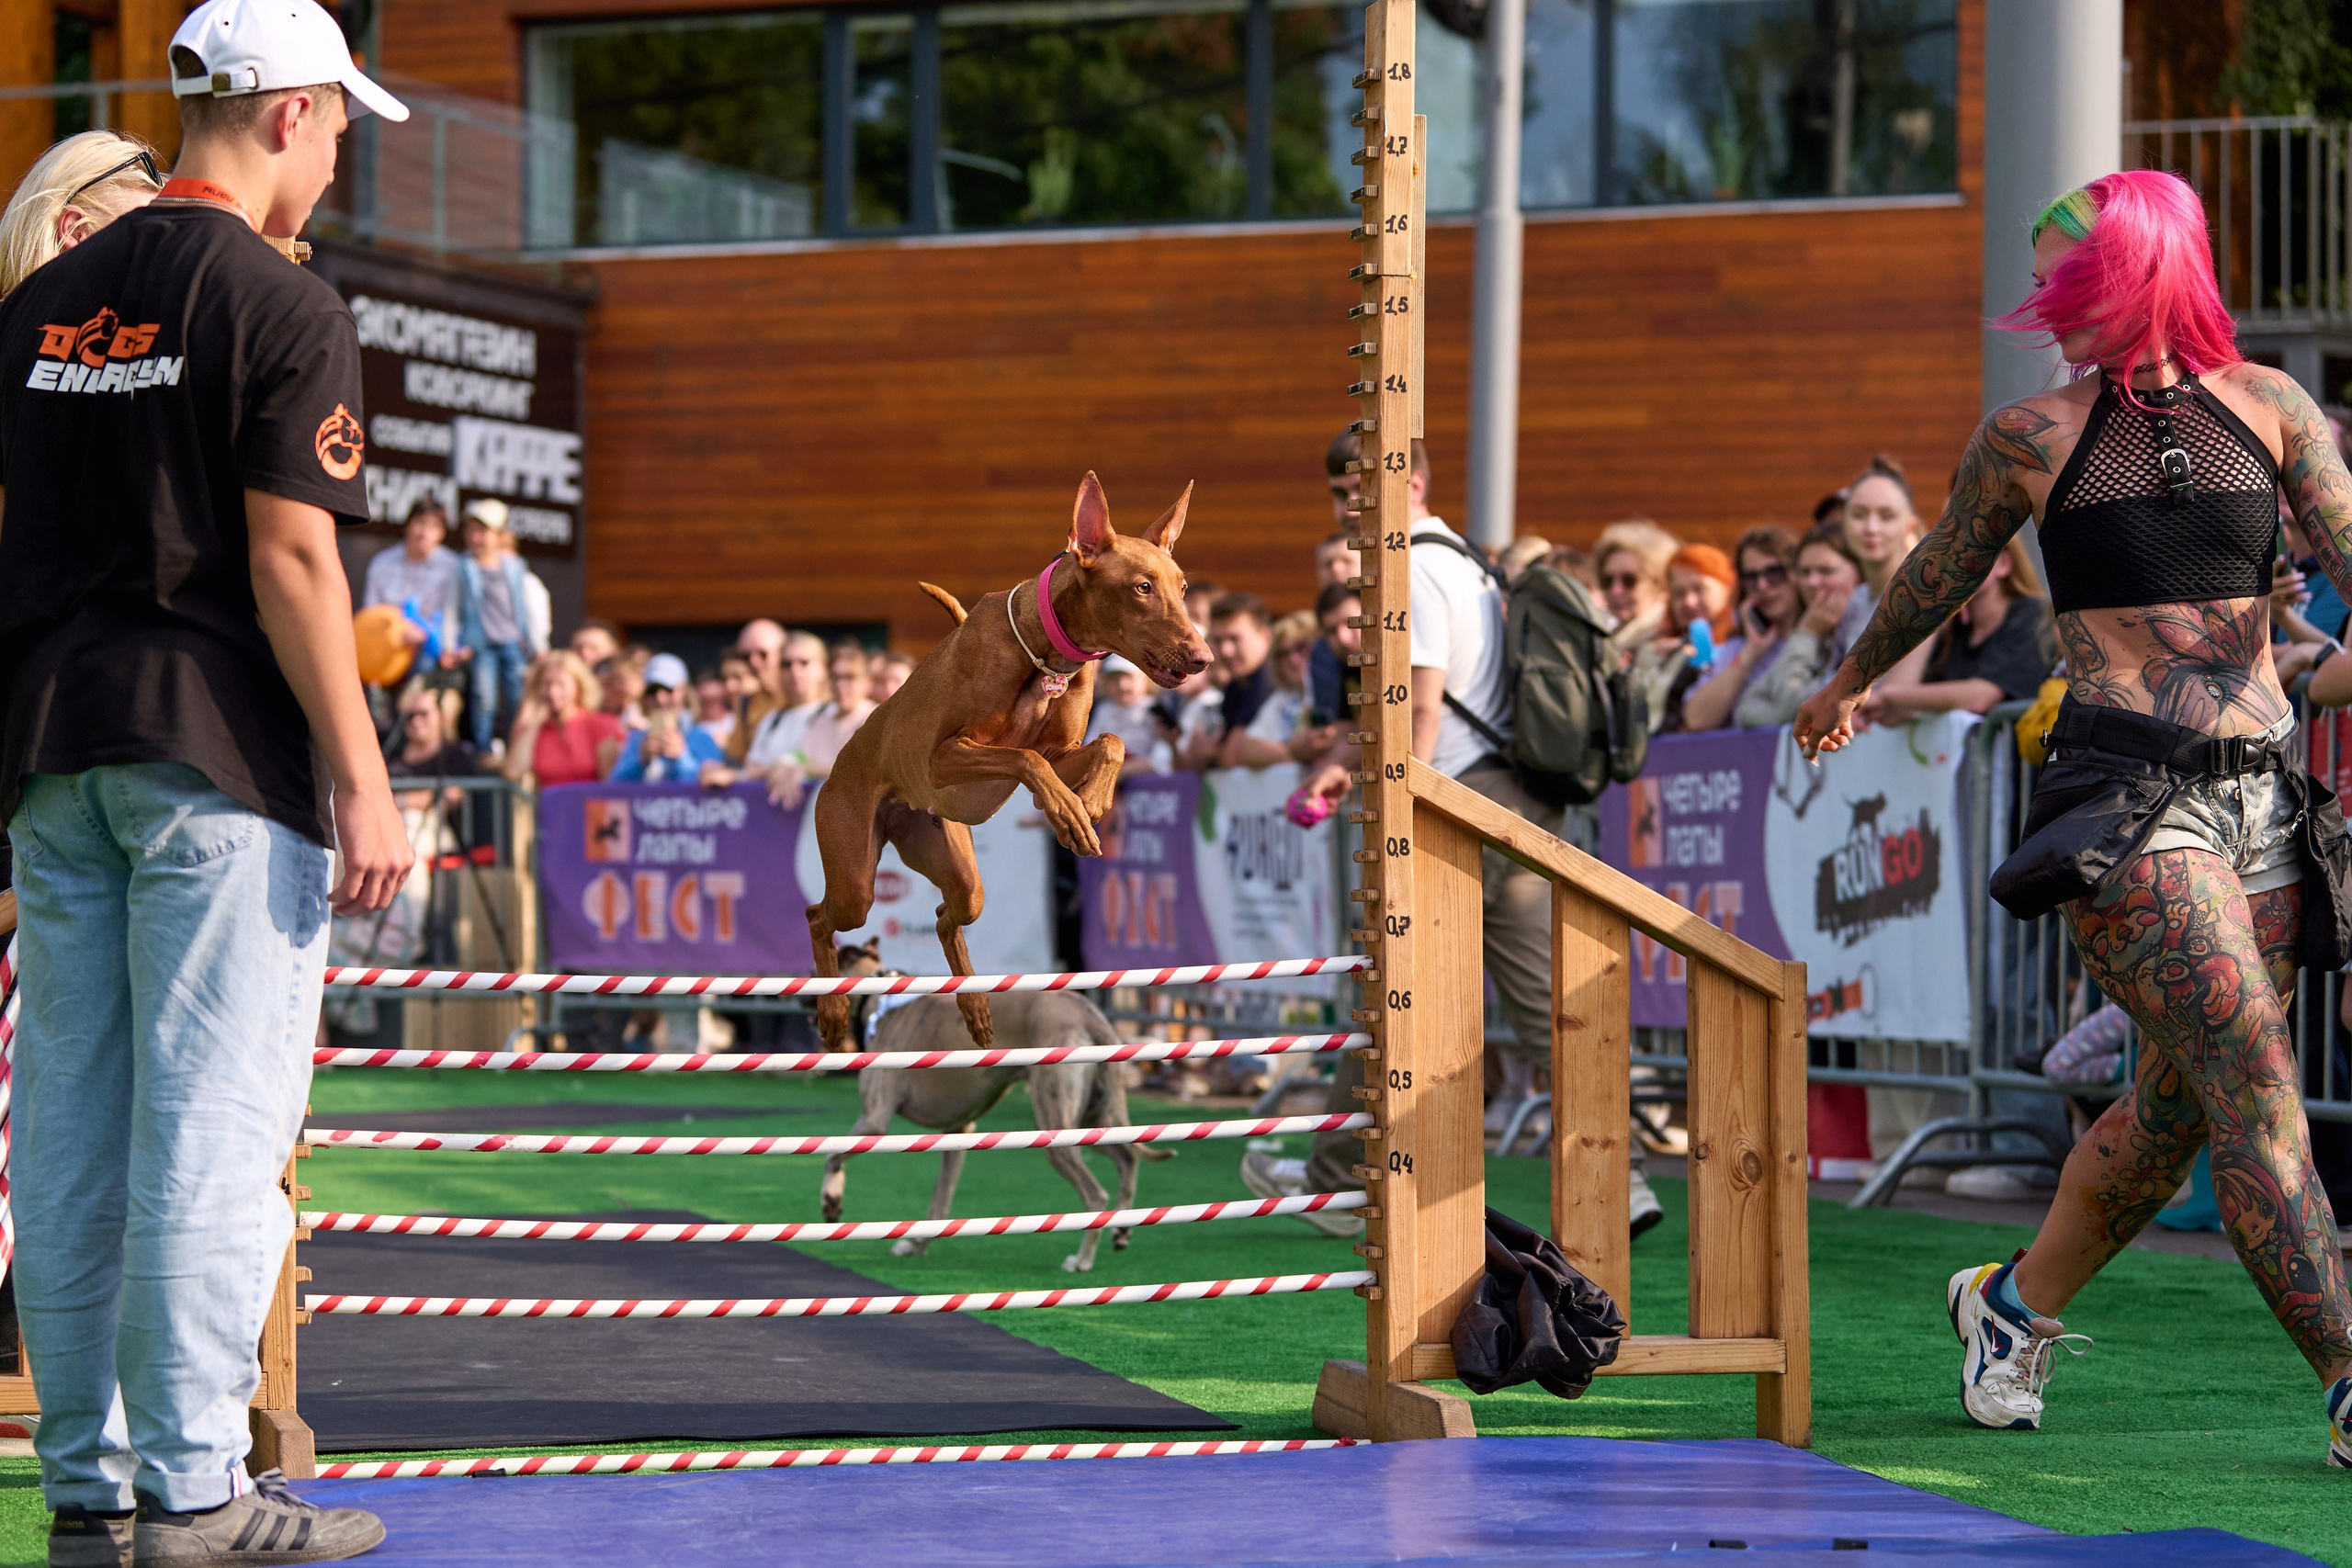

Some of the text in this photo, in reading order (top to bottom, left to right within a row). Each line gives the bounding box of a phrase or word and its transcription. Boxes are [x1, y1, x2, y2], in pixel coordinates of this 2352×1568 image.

[1387, 62, 1411, 81] 1,8
[1386, 136, 1408, 157] 1,7
[1385, 214, 1408, 234] 1,6
[1385, 296, 1408, 316] 1,5
[1385, 374, 1407, 393] 1,4
[1384, 452, 1406, 473] 1,3
[366, 463, 459, 530] НИГИ
[1385, 531, 1406, 551] 1,2
[1384, 611, 1407, 632] 1,1
[1384, 684, 1408, 705] 1,0
[1385, 762, 1405, 783] 0,9
[1386, 837, 1410, 858] 0,8
[582, 870, 745, 944] ФЕСТ
[1385, 915, 1410, 938] 0,7
[1387, 989, 1411, 1011] 0,6
[1388, 1069, 1412, 1092] 0,5
[1389, 1150, 1413, 1176] 0,4
